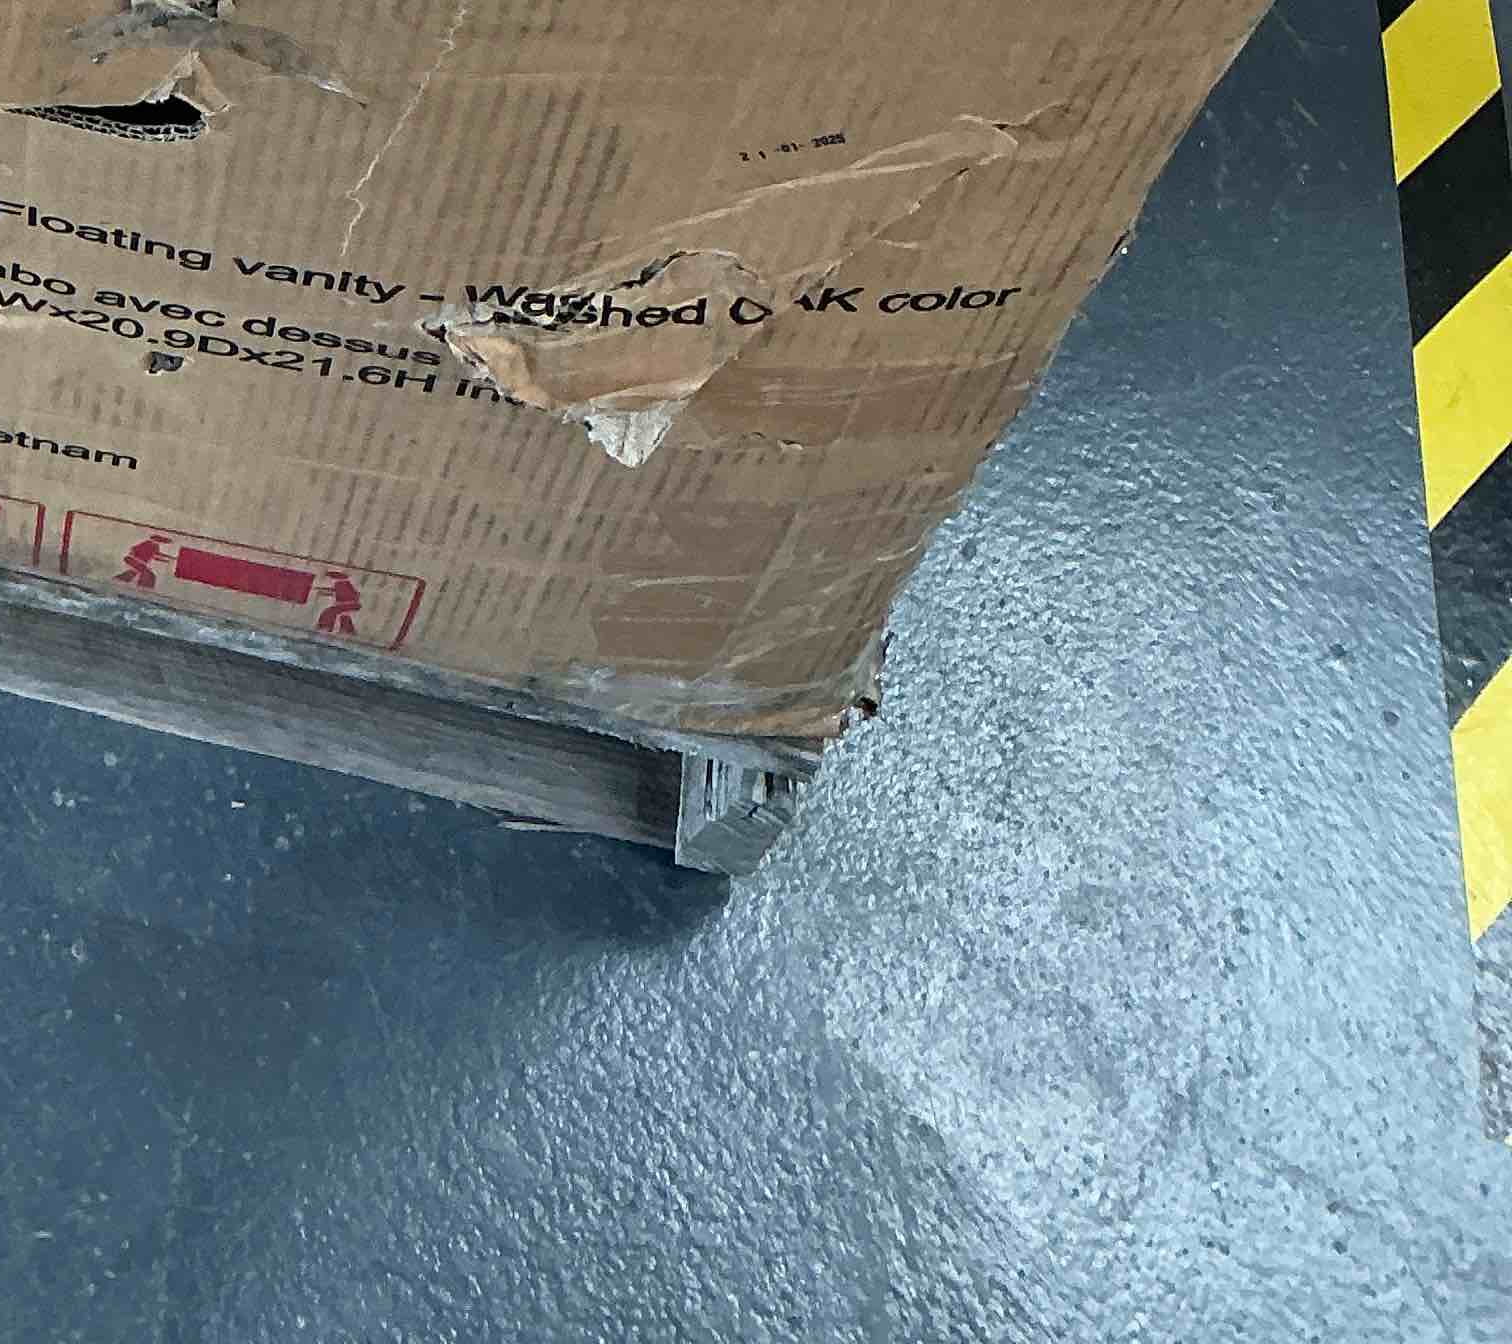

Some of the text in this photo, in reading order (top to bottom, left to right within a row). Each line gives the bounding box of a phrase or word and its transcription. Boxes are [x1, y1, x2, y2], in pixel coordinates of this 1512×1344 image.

[233, 254, 406, 307] vanity
[878, 285, 1022, 314] color
[93, 286, 228, 329] avec
[241, 312, 442, 366] dessus
